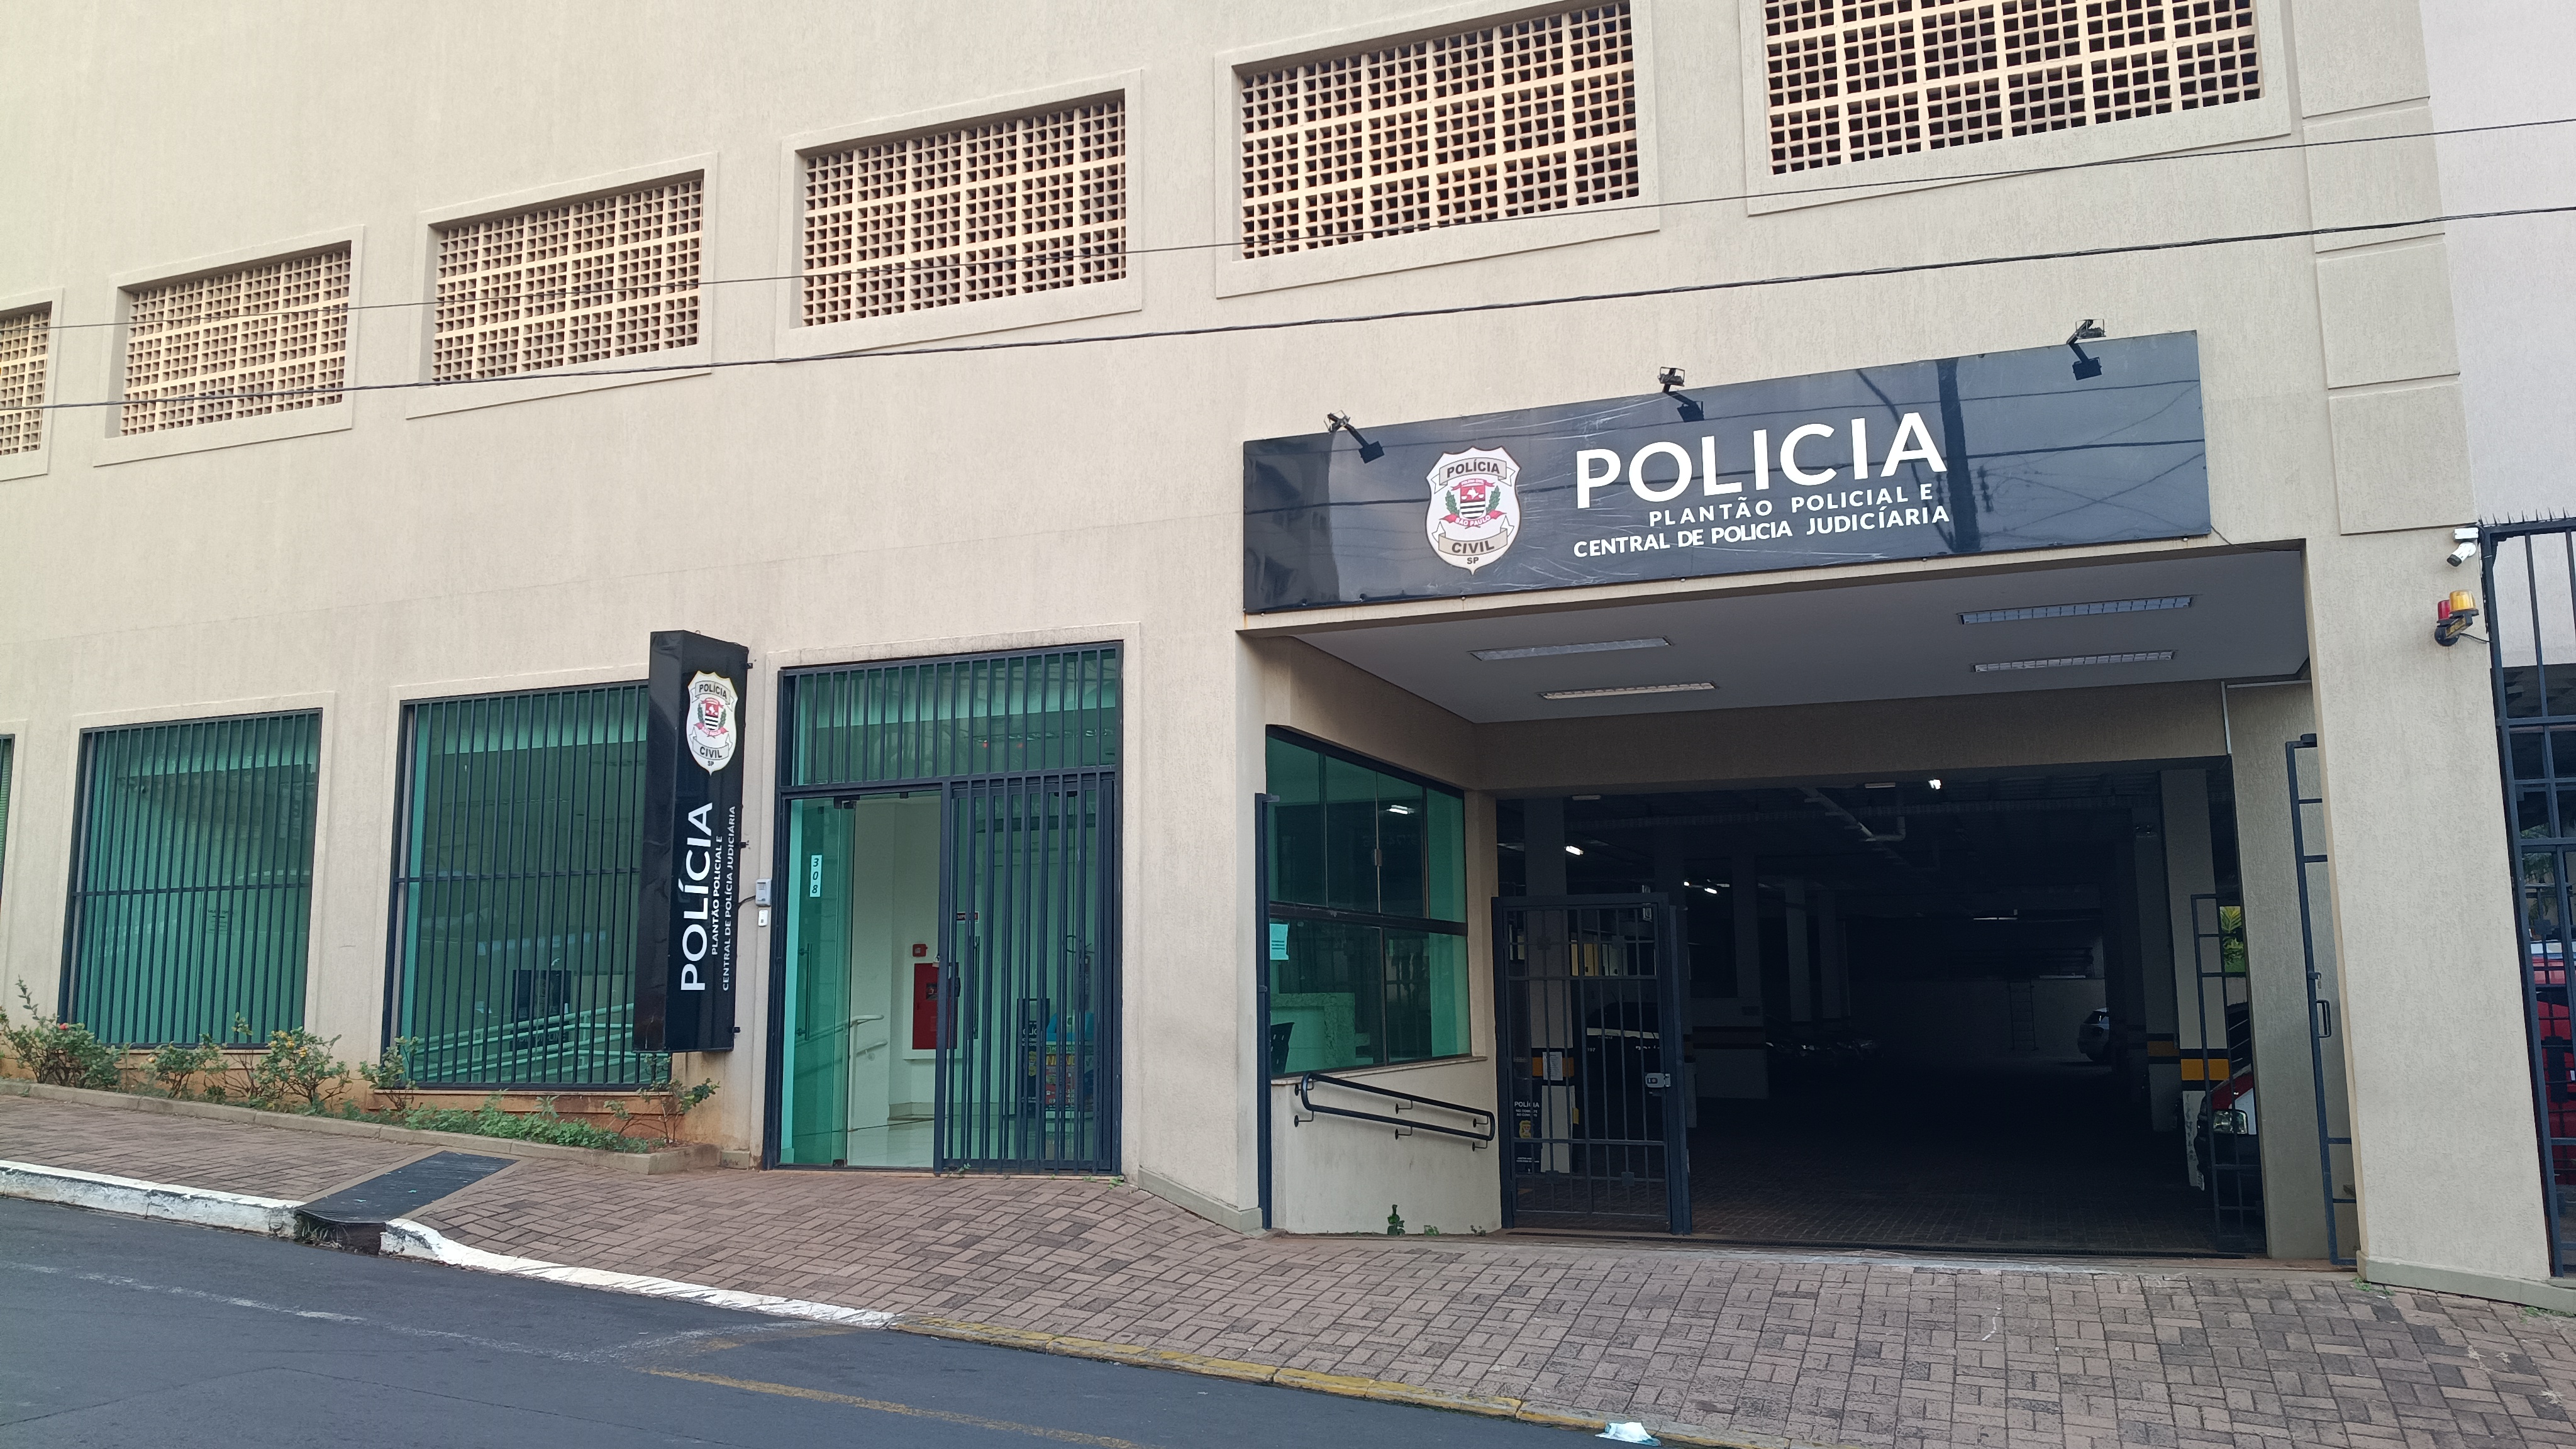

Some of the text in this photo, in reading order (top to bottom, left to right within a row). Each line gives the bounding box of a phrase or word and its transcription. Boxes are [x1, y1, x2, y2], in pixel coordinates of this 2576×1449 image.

[1447, 459, 1500, 478] POLÍCIA
[1576, 412, 1947, 509] POLICIA
[1469, 515, 1491, 526] PAULO
[1649, 483, 1933, 527] PLANTÃO POLICIAL E
[1452, 540, 1495, 554] CIVIL
[1574, 505, 1950, 557] CENTRAL DE POLICIA JUDICÍARIA
[1467, 557, 1479, 565] SP
[699, 683, 727, 699] POLÍCIA
[699, 746, 723, 758] CIVIL
[713, 845, 723, 897] POLICIAL
[811, 857, 819, 894] 308
[678, 802, 713, 991] POLÍCIA
[723, 806, 736, 991] CENTRAL DE POLÍCIA JUDICIÁRIA
[711, 899, 719, 955] PLANTÃO
